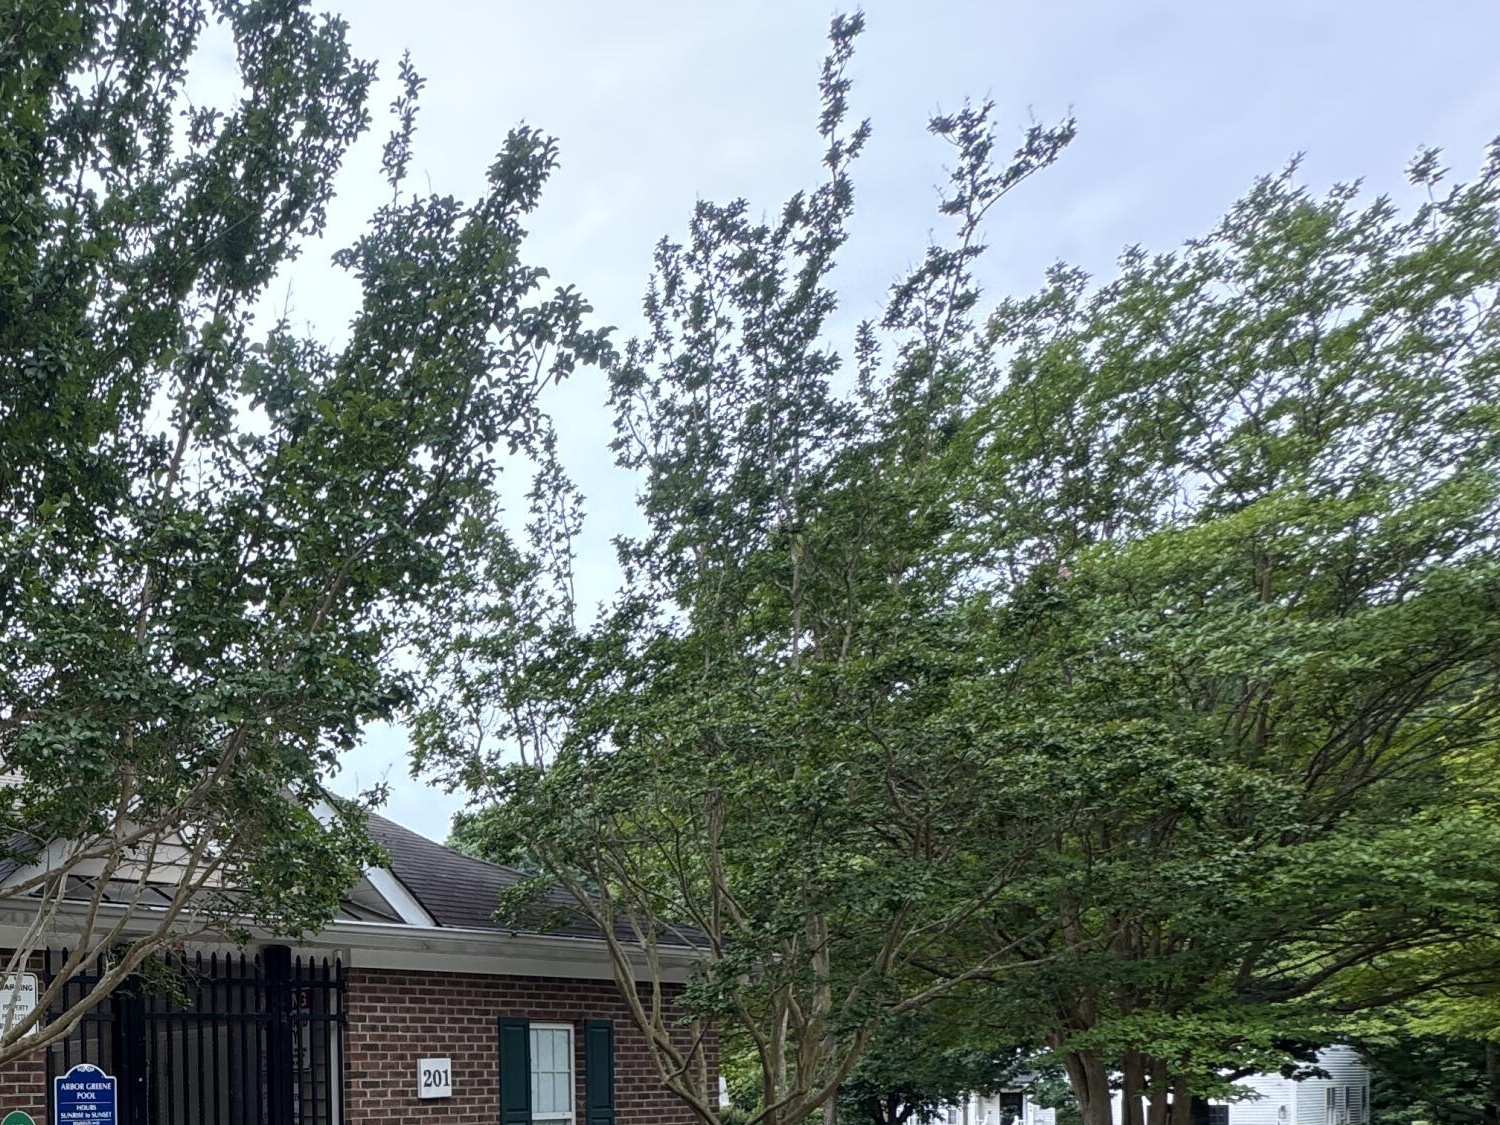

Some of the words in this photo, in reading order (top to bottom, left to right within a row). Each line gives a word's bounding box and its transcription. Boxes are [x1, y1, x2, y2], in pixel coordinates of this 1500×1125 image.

[423, 1069, 450, 1088] 201
[60, 1082, 85, 1090] ARBOR
[85, 1082, 112, 1090] GREENE
[76, 1091, 97, 1099] POOL
